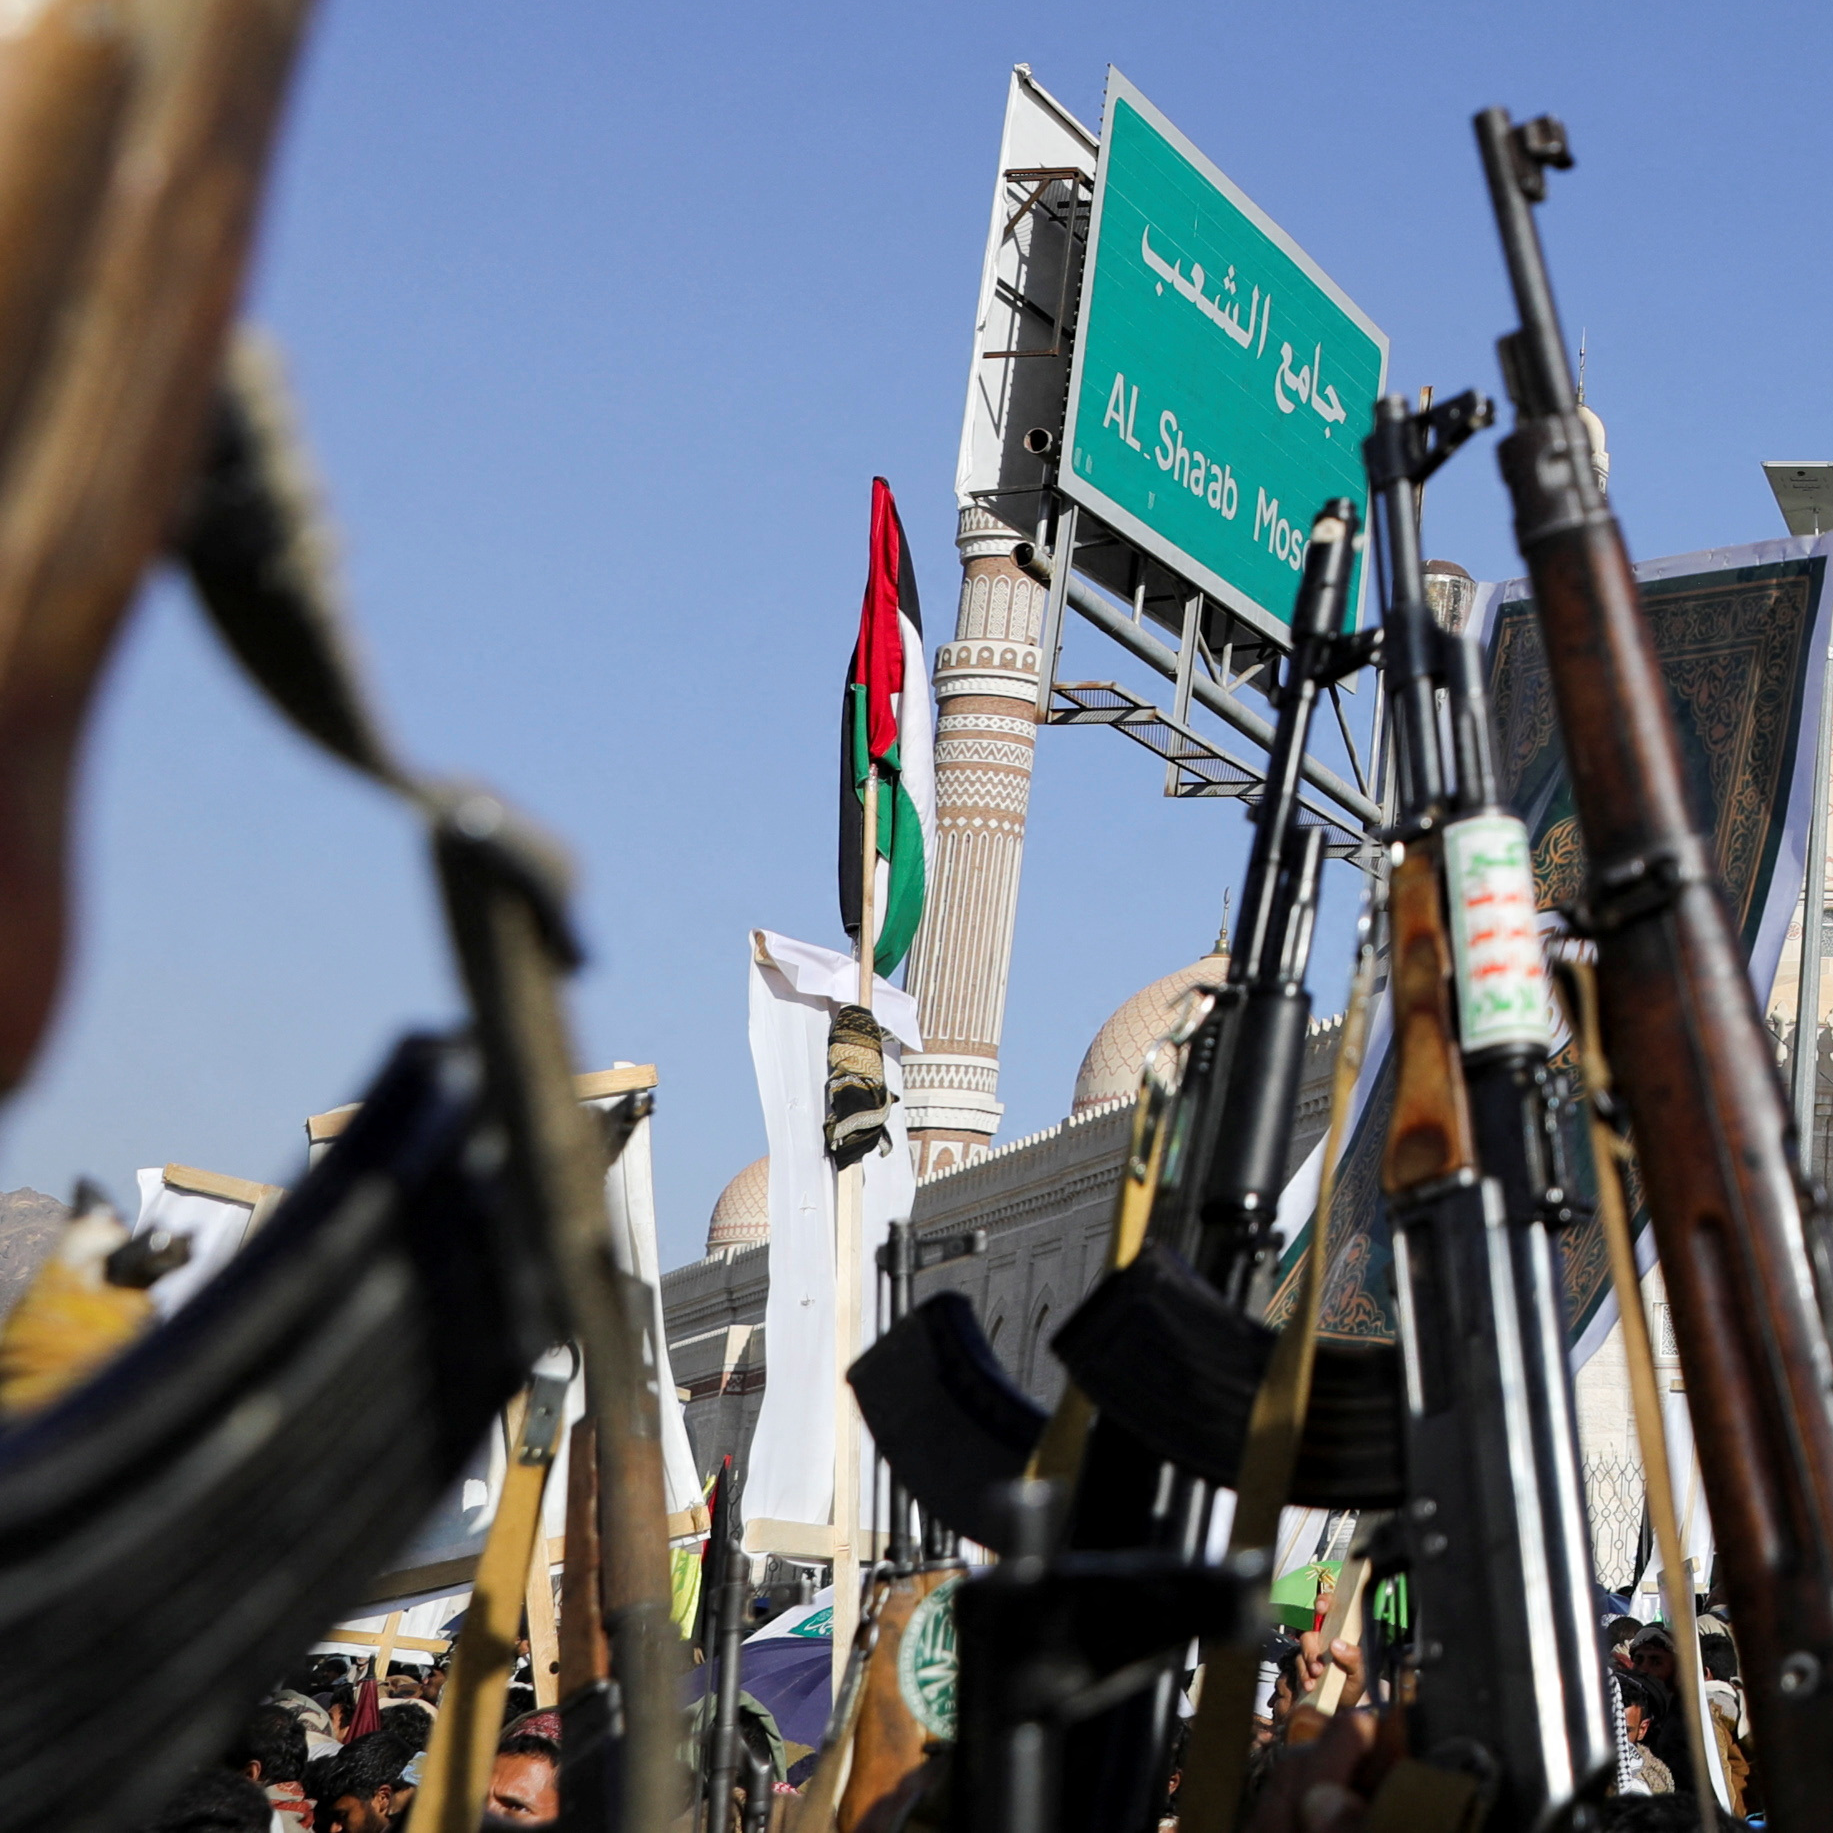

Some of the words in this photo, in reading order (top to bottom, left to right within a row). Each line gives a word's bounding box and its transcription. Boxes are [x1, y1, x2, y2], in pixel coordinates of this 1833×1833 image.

[1141, 223, 1271, 360] الشعب
[1274, 341, 1347, 440] جامع
[1253, 485, 1311, 574] Mos
